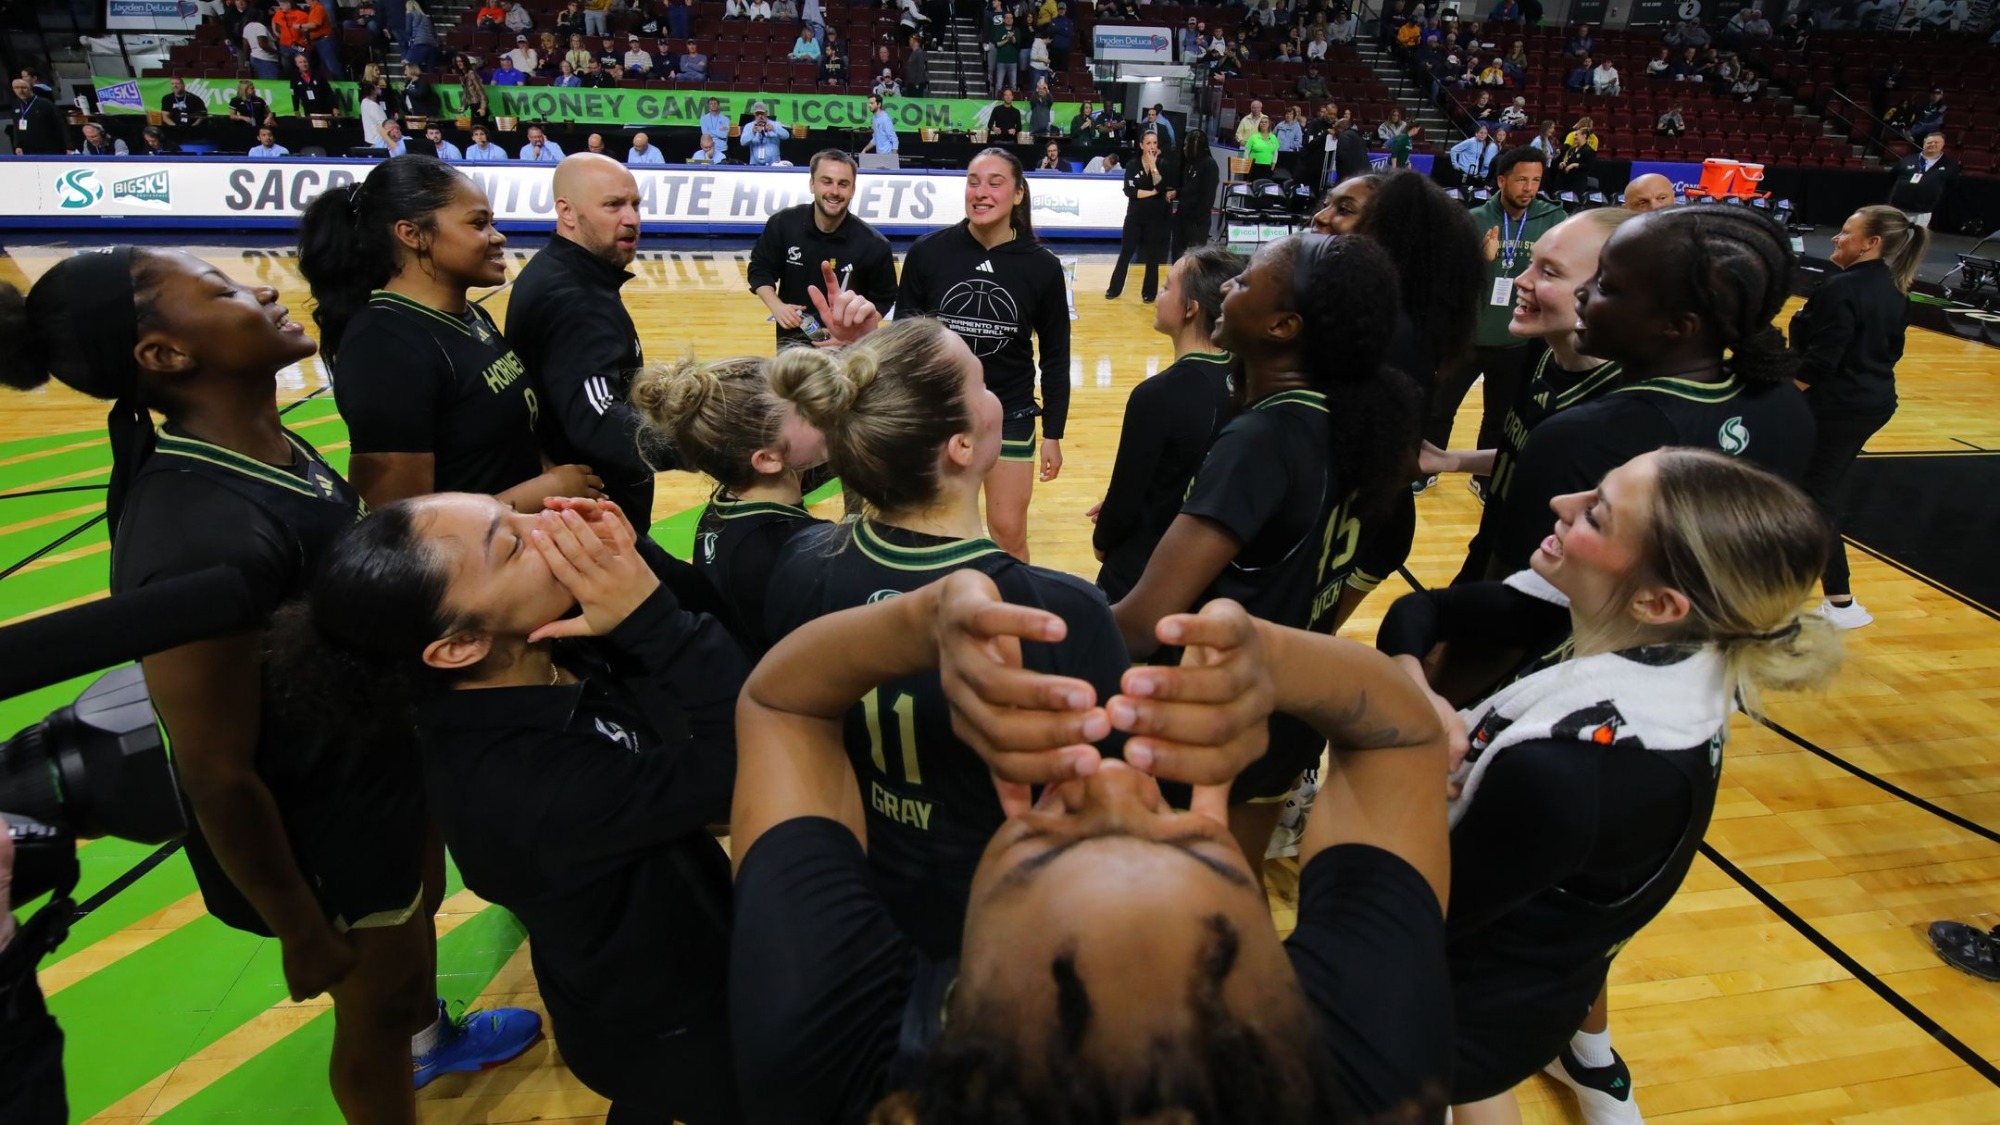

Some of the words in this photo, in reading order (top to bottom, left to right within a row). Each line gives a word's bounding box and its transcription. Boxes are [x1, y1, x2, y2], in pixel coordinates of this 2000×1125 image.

[501, 93, 626, 118] MONEY
[637, 95, 731, 119] GAME
[744, 98, 780, 117] AT
[792, 100, 950, 127] ICCUCOM
[482, 350, 526, 394] HORNE
[860, 687, 922, 785] 11
[871, 780, 932, 831] GRAY
